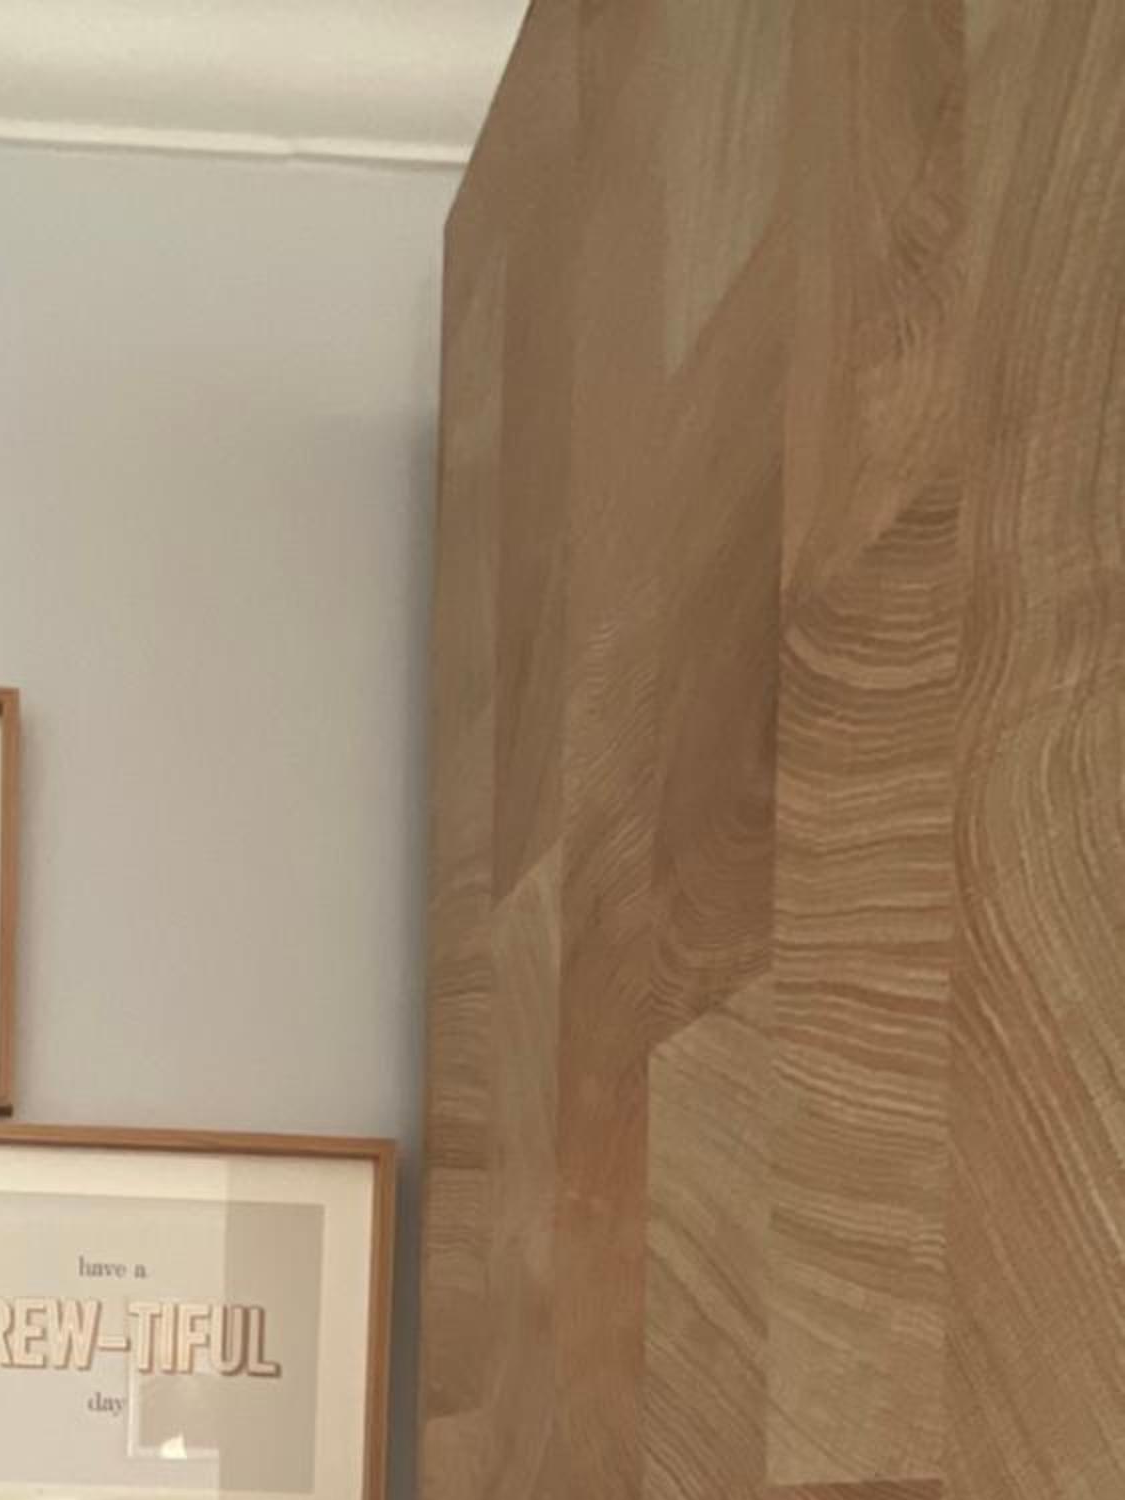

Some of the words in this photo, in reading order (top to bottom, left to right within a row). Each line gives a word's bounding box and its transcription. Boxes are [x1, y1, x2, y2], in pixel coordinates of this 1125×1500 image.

[78, 1256, 126, 1278] have
[134, 1263, 147, 1278] a
[88, 1392, 126, 1416] day
